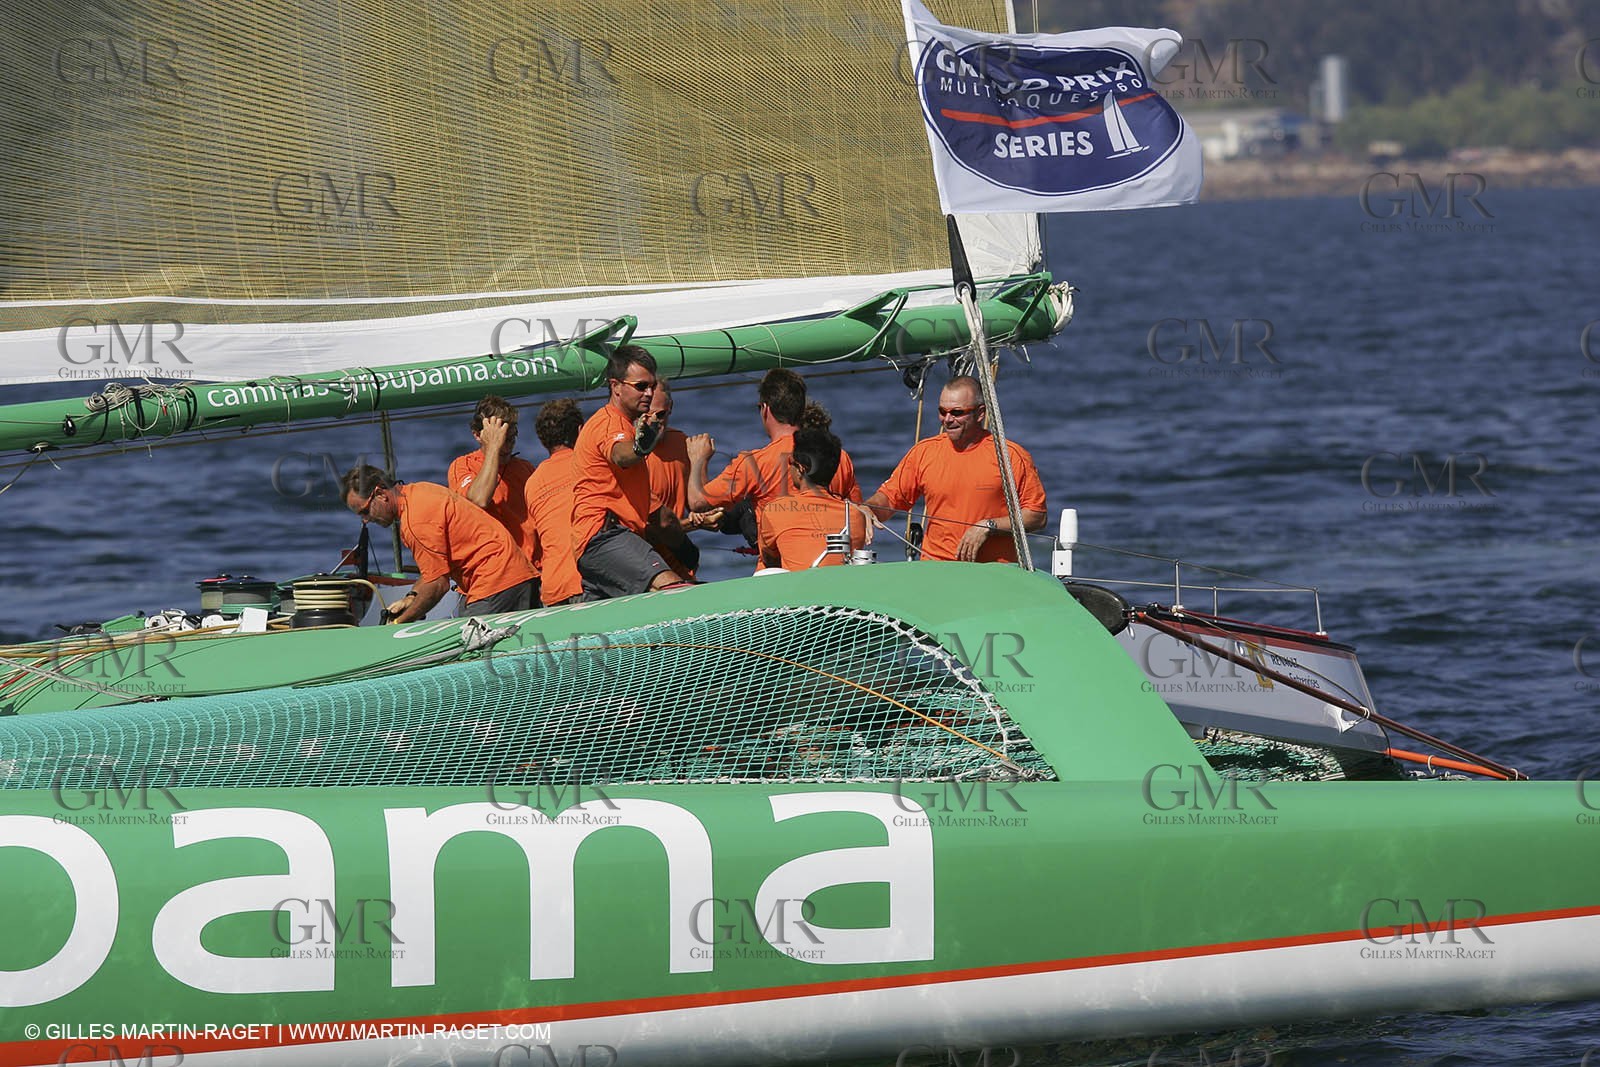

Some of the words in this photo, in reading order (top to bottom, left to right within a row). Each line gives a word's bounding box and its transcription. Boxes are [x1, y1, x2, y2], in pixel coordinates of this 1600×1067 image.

[1056, 61, 1137, 92] PRIX
[1116, 78, 1142, 92] 60
[993, 131, 1094, 159] SERIES
